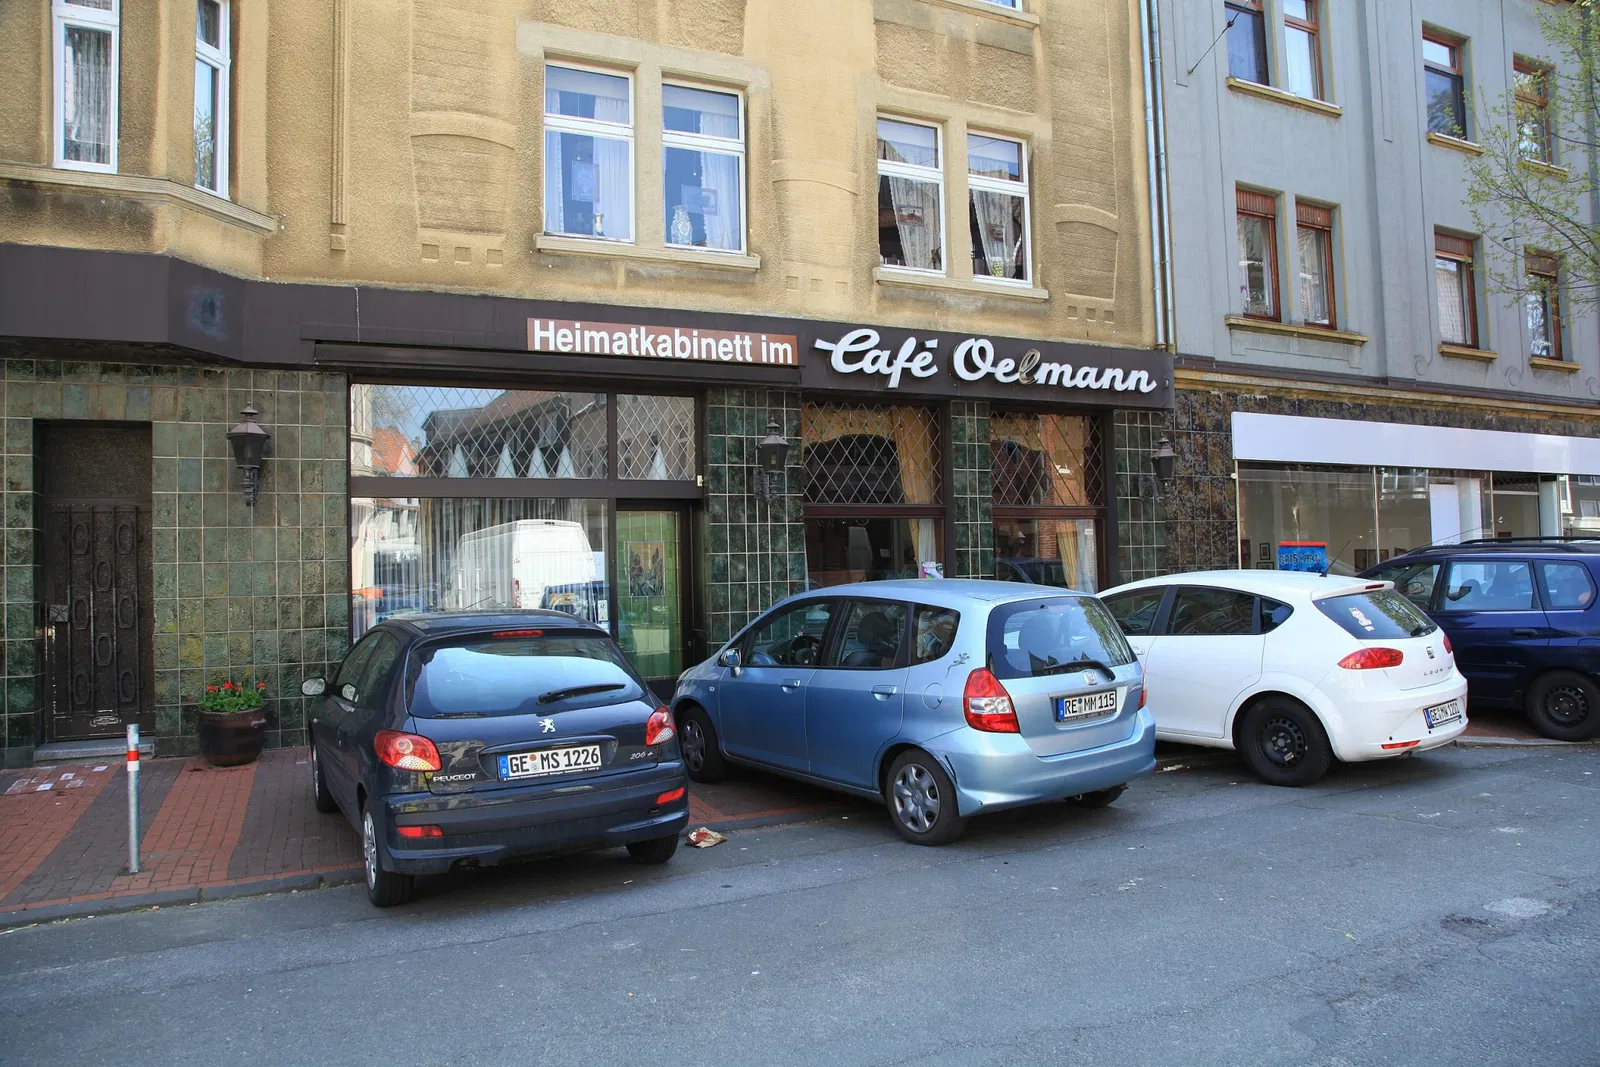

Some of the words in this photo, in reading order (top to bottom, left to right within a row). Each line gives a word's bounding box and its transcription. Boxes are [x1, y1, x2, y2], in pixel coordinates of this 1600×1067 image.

[533, 319, 753, 362] Heimatkabinett
[760, 330, 793, 364] im
[814, 328, 939, 389] Café
[954, 337, 1157, 393] Oelmann
[1065, 699, 1078, 715] RE
[1084, 696, 1097, 712] MM
[1098, 693, 1115, 709] 115
[509, 755, 530, 774] GE
[540, 751, 560, 770] MS
[563, 747, 600, 768] 1226
[433, 773, 477, 782] PEUGEOT
